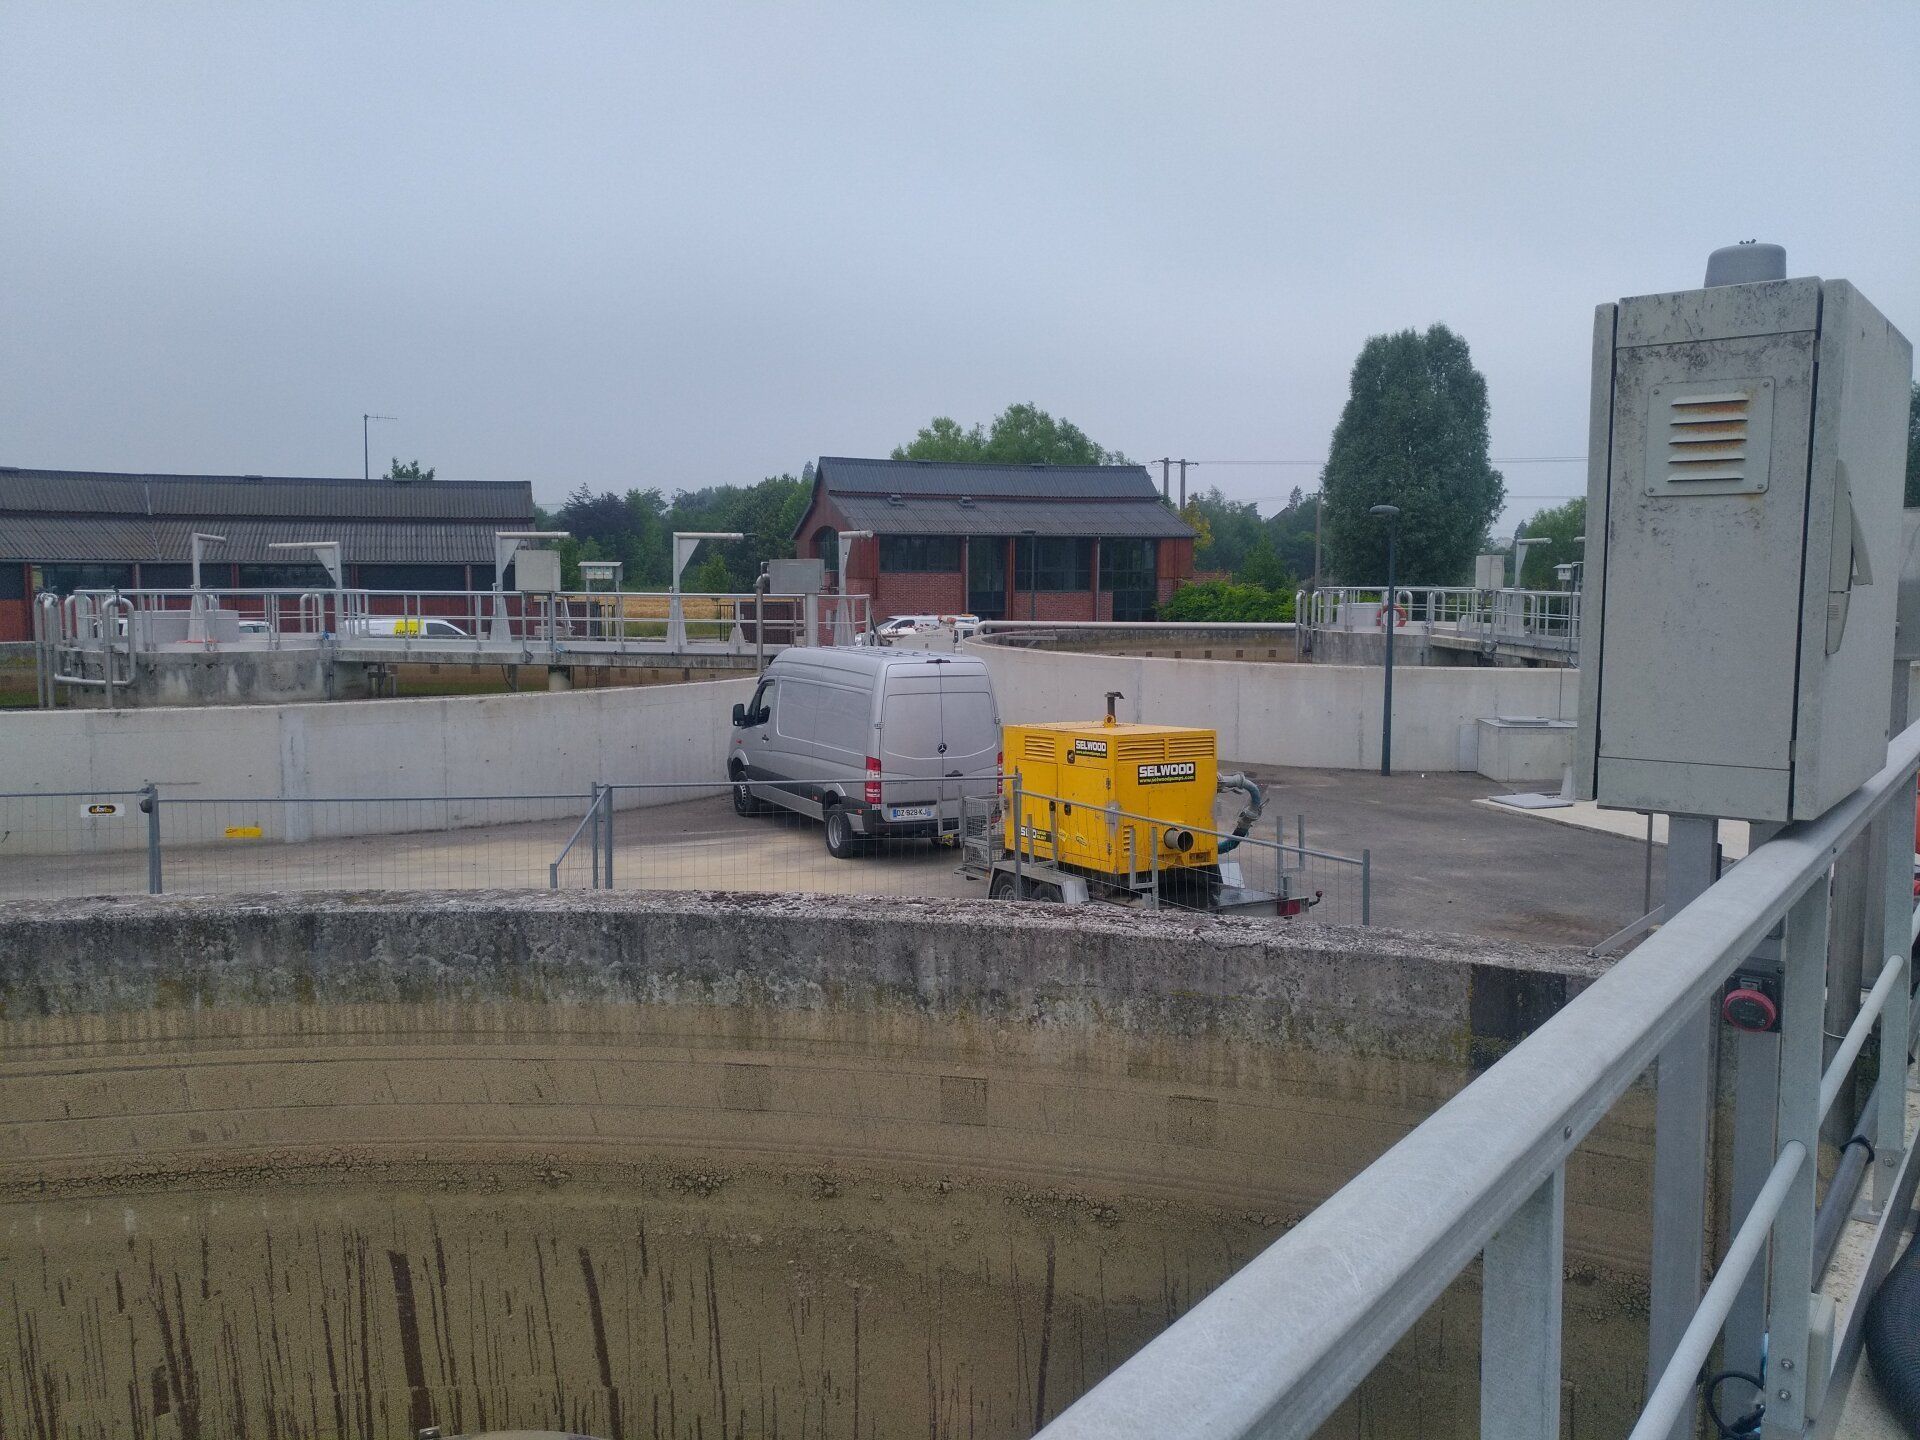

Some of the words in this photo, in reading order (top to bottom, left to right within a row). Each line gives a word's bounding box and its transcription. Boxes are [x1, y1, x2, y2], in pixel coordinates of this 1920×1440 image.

[1076, 740, 1107, 752] SELWOOD
[1139, 763, 1195, 778] SELWOOD
[1139, 775, 1195, 783] www.selwoodpumps.com
